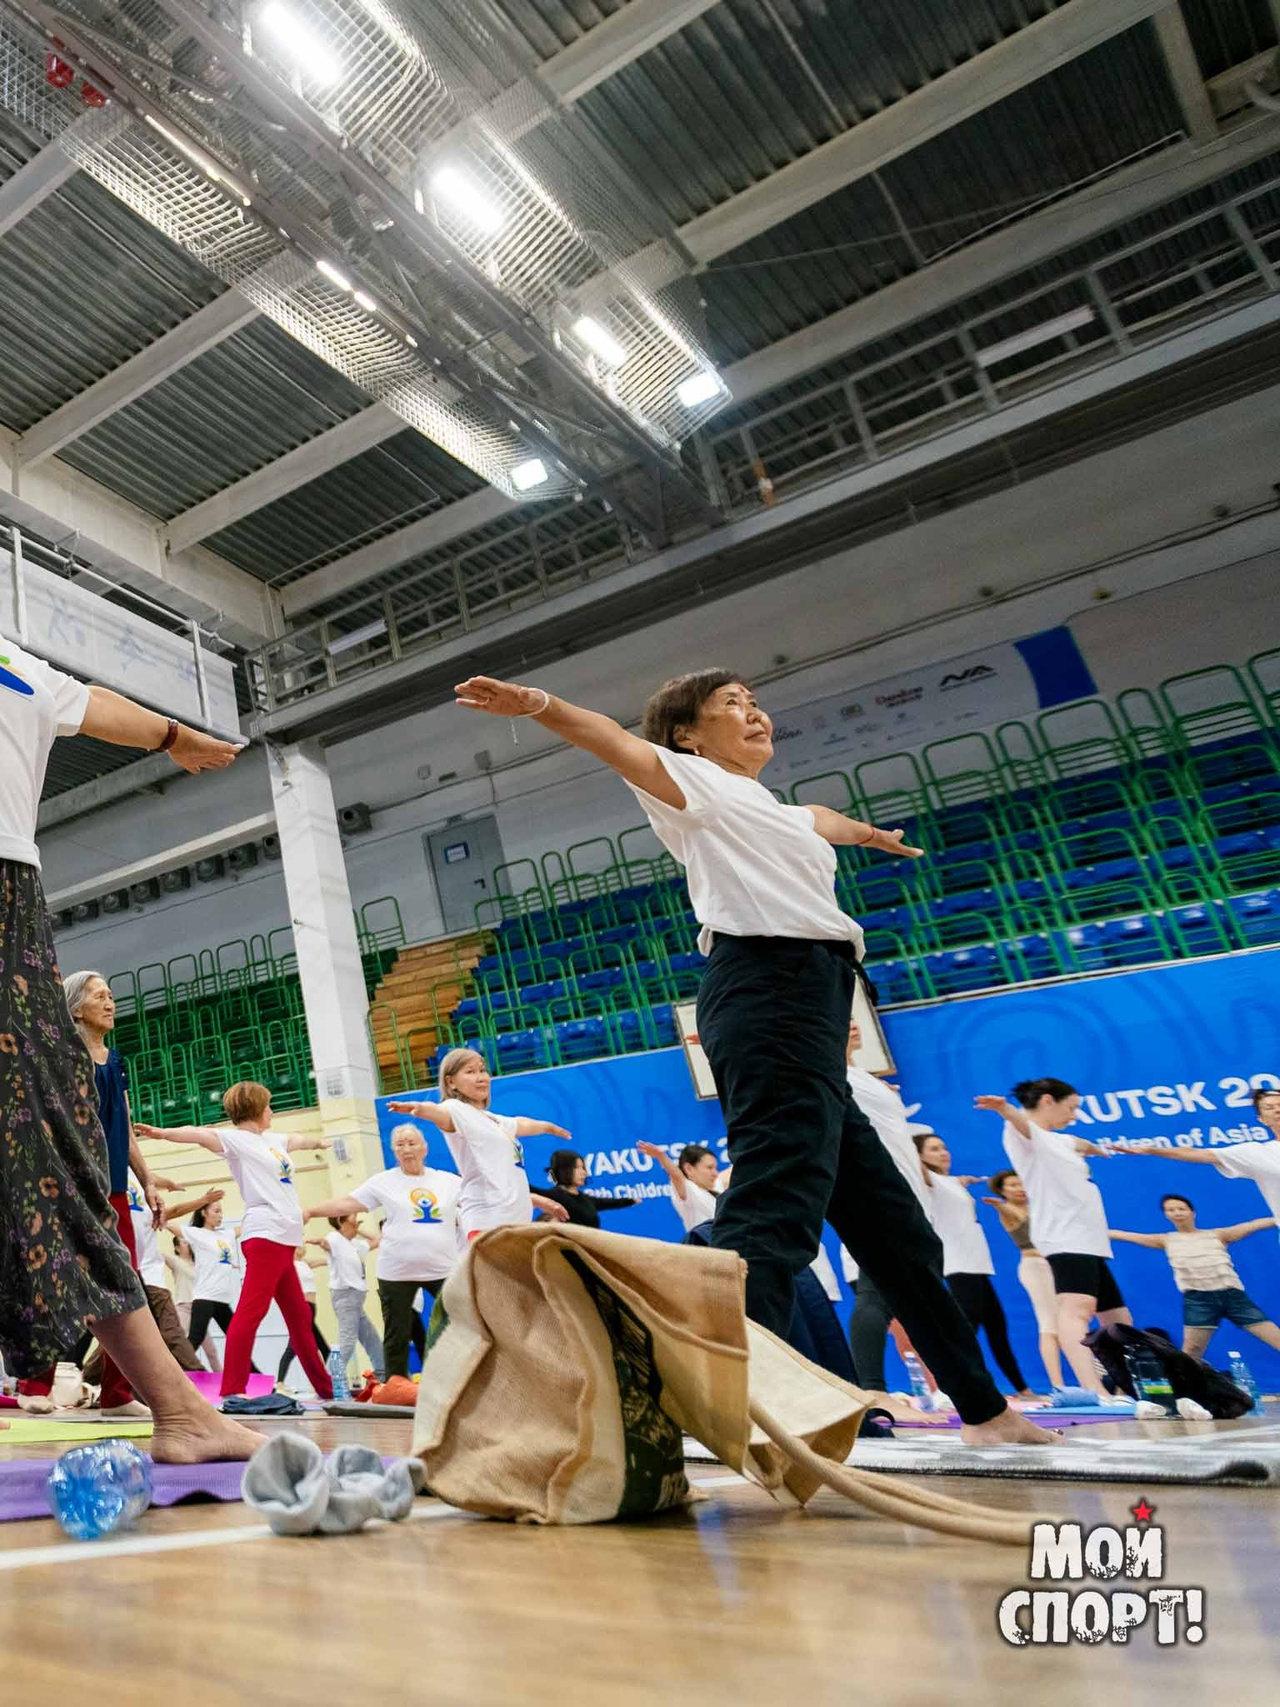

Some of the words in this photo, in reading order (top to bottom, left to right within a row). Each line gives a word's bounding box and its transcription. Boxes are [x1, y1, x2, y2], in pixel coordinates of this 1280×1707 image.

[1069, 1081, 1217, 1126] KUTSK
[1208, 1123, 1270, 1145] Asia
[613, 1181, 674, 1200] Childre
